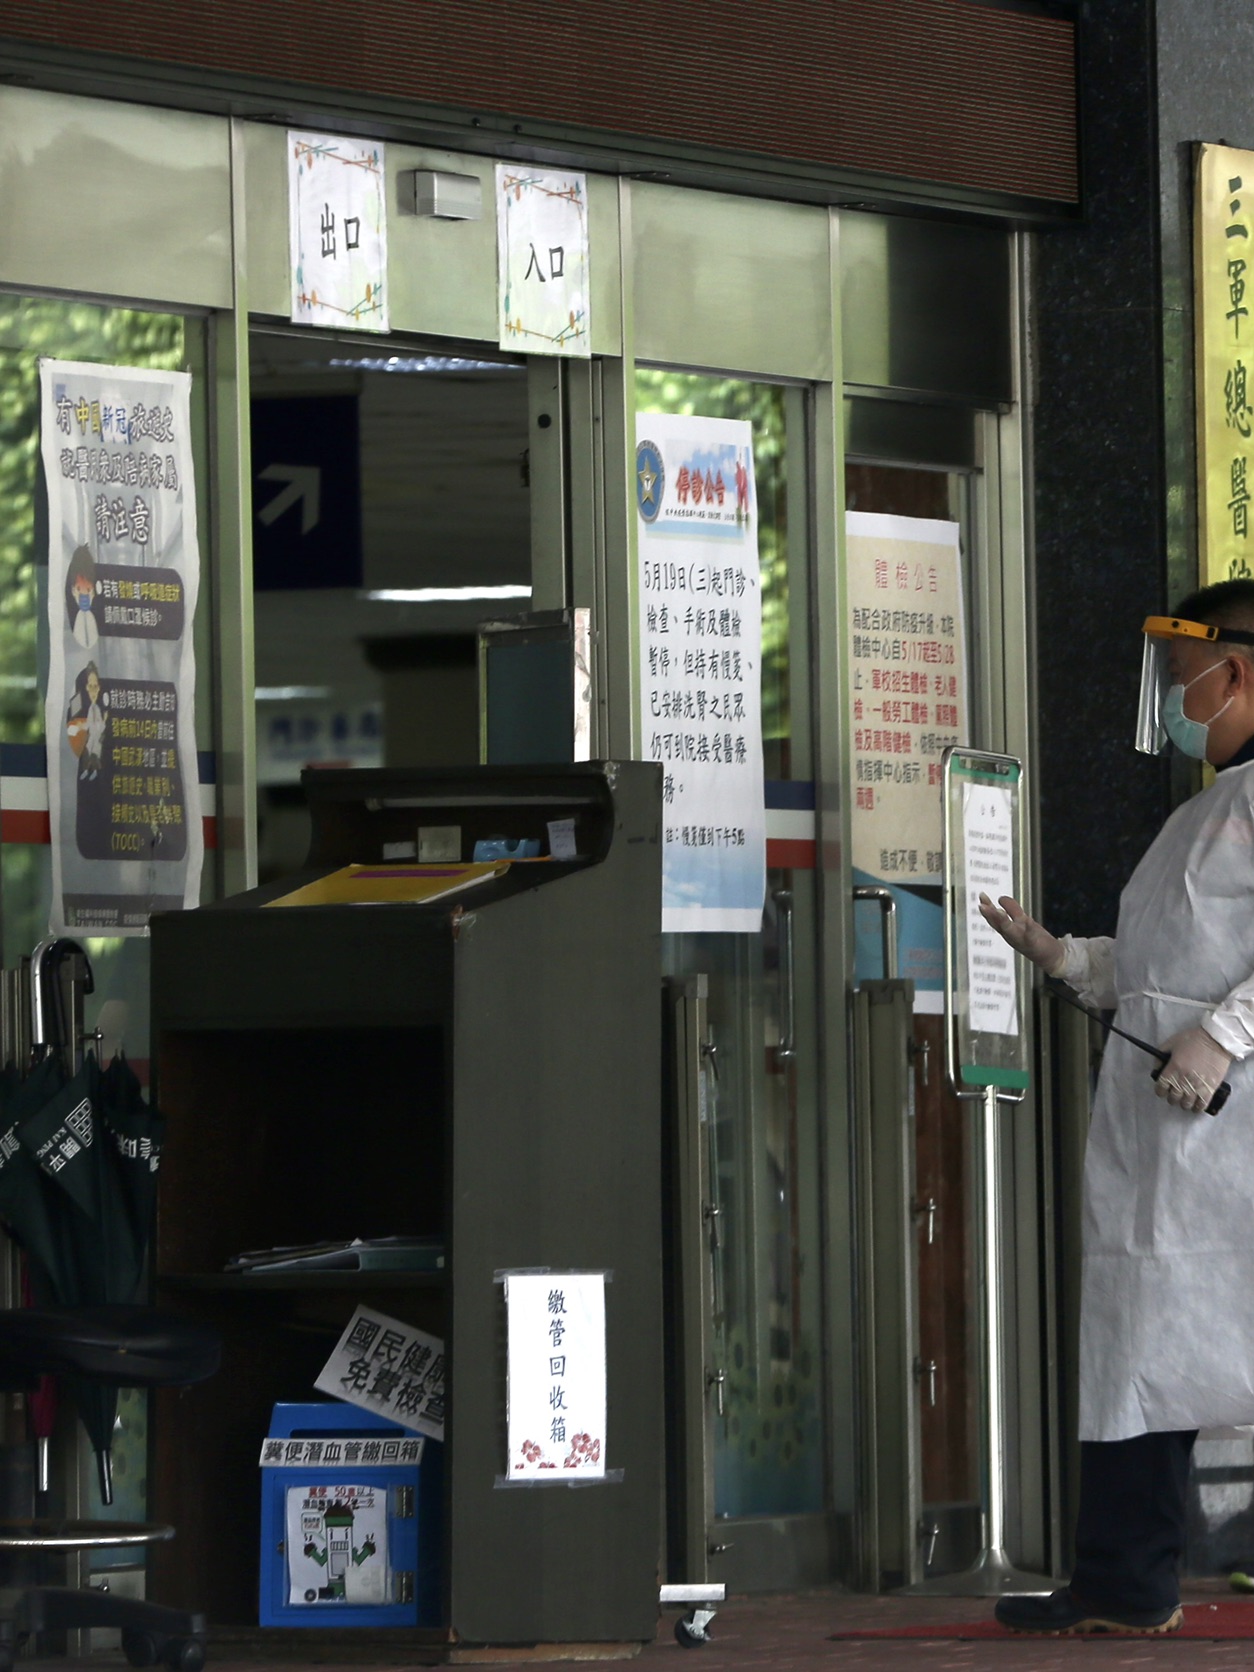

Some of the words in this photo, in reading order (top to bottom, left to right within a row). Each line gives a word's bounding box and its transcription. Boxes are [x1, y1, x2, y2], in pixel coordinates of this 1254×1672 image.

[320, 202, 361, 260] 出口
[524, 242, 565, 283] 入口
[675, 465, 726, 505] 停診公告
[95, 495, 149, 544] 請注意
[875, 559, 937, 592] 體檢公告
[647, 603, 742, 638] 檢查、手術及體檢
[650, 732, 747, 764] 仍可到院接受醫療
[41, 1136, 82, 1174] 開平
[548, 1289, 568, 1443] 繳管回收箱
[341, 1357, 444, 1426] 免費檢查
[264, 1441, 420, 1462] 糞便潛血管繳回箱
